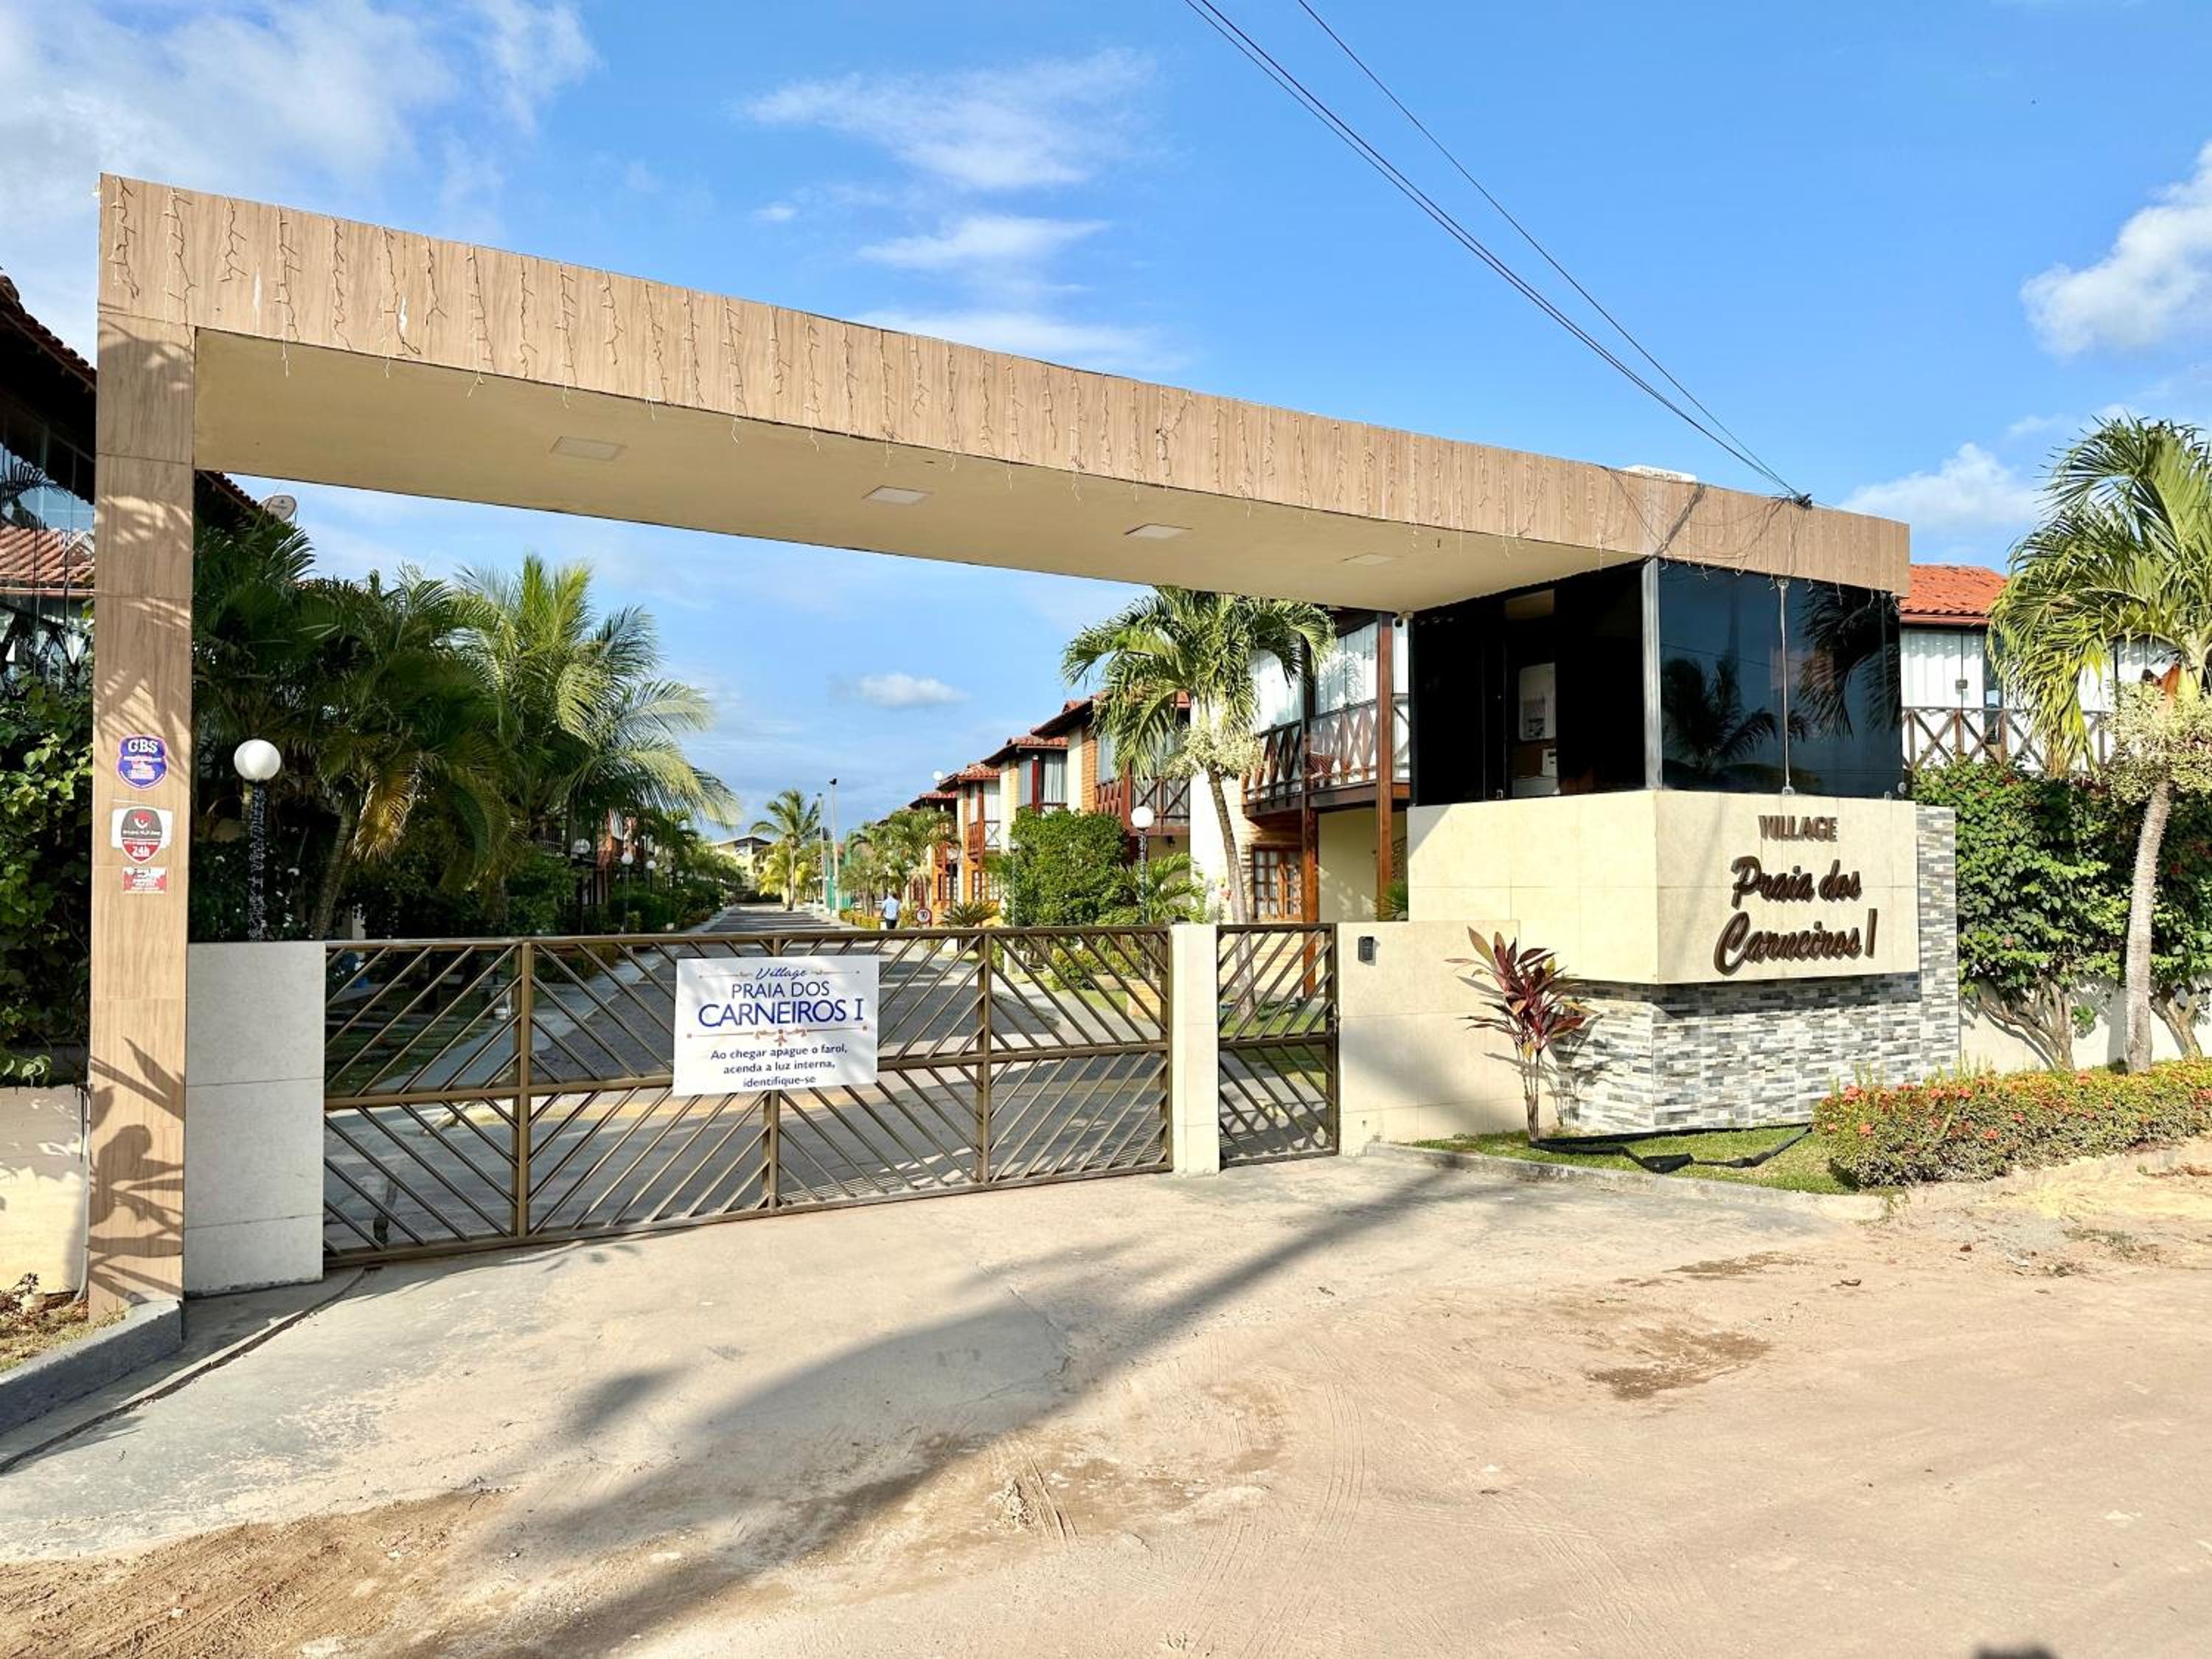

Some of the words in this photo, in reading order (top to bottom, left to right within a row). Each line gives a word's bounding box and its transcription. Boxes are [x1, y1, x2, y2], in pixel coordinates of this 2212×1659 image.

[128, 738, 159, 753] GBS
[1757, 815, 1838, 842] VILLAGE
[1731, 855, 1815, 910] Praia
[1818, 859, 1863, 902] dos
[1714, 911, 1863, 976] Carneiros
[756, 967, 808, 981] Village
[731, 982, 785, 999] PRAIA
[791, 981, 830, 998] DOS
[698, 998, 847, 1027] CARNEIROS
[854, 998, 864, 1021] I
[710, 1050, 726, 1060] Ao
[729, 1049, 767, 1061] chegar
[769, 1047, 808, 1059] apague
[821, 1044, 848, 1054] farol,
[723, 1062, 762, 1074] acenda
[765, 1064, 772, 1072] a
[775, 1061, 791, 1071] luz
[794, 1060, 836, 1070] interna,
[742, 1076, 816, 1088] identifique-se
